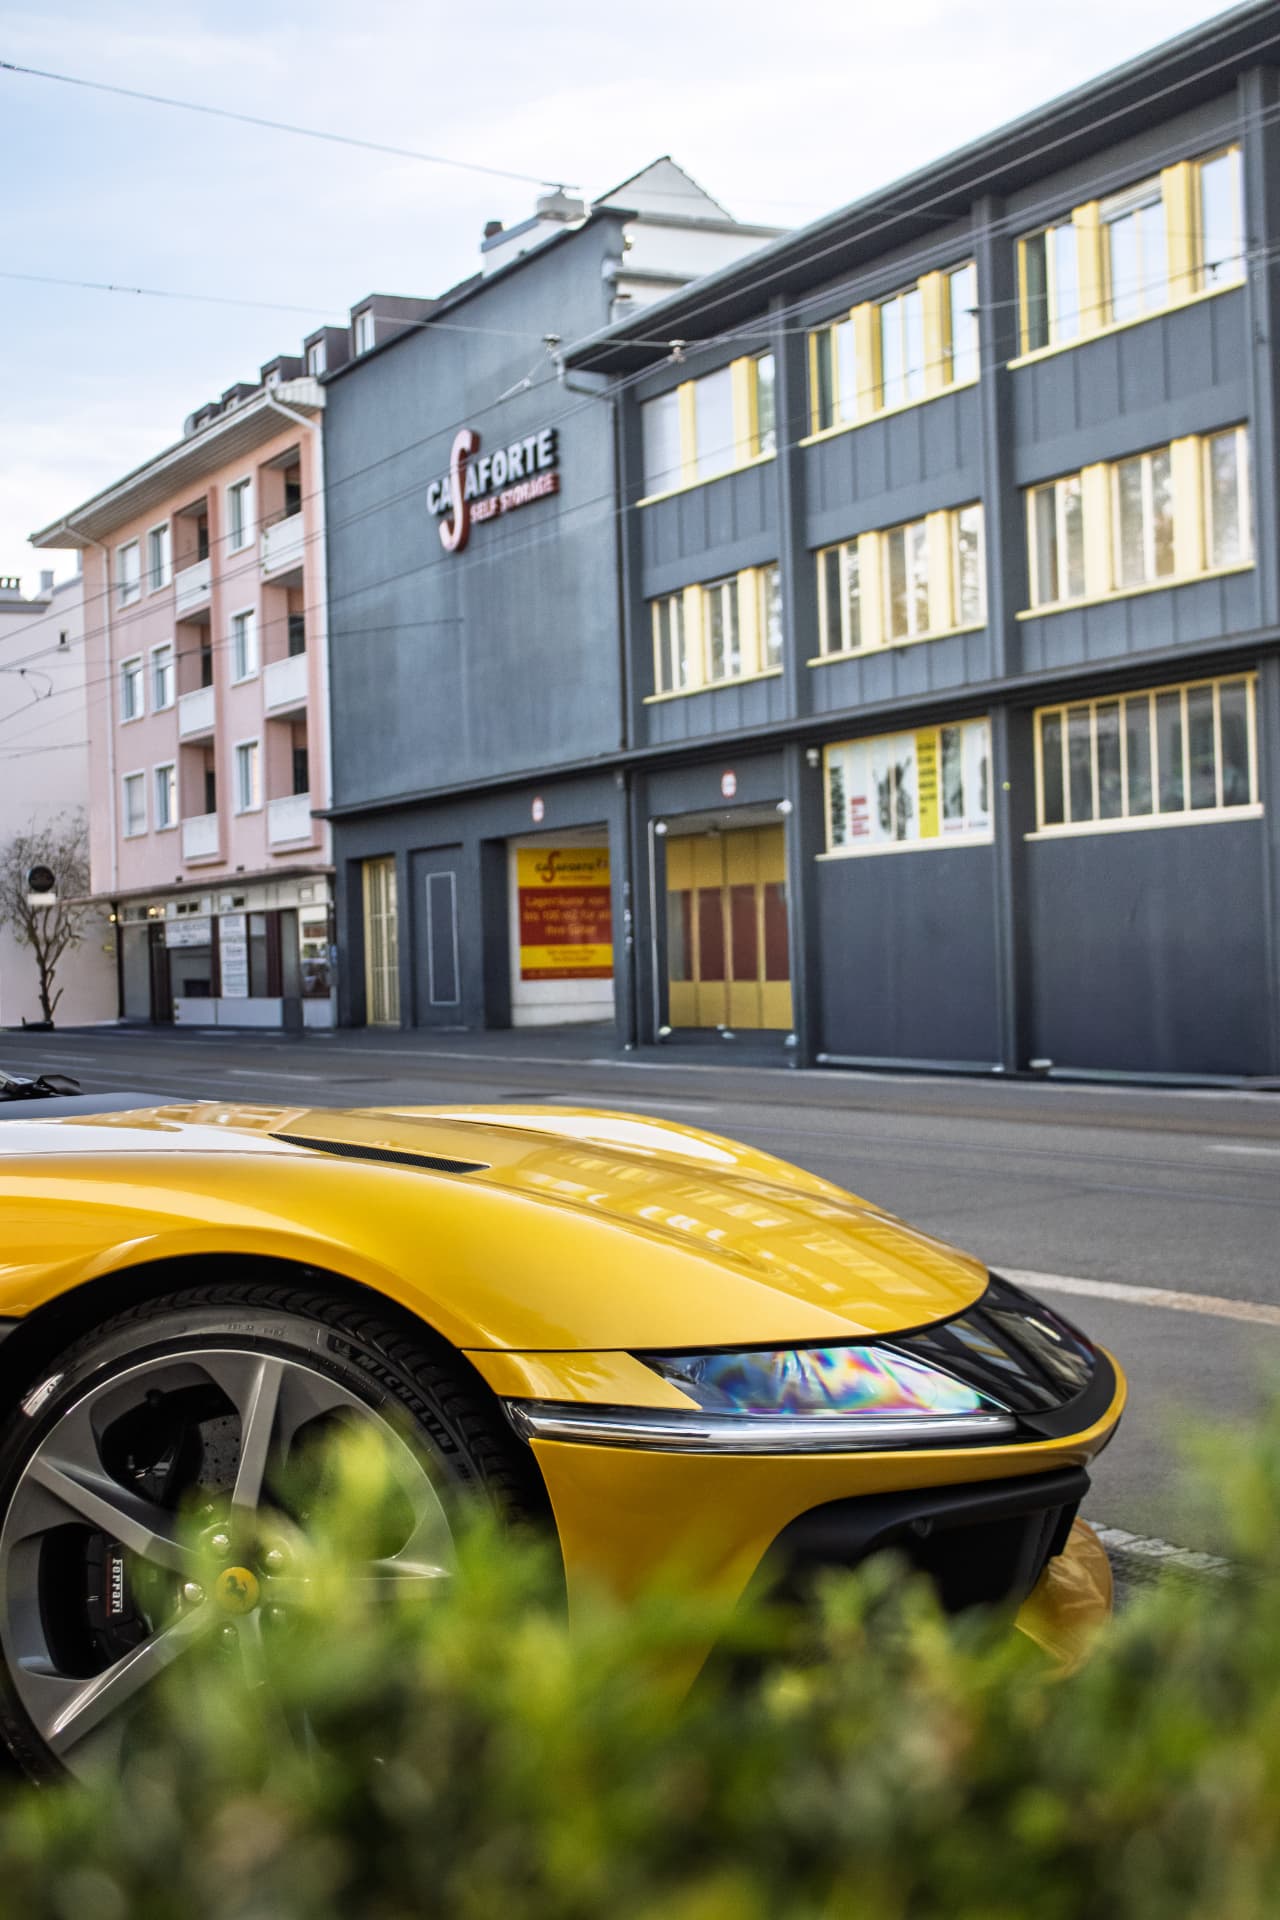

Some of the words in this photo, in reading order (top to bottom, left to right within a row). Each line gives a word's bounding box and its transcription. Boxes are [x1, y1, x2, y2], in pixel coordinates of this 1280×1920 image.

[426, 429, 557, 552] CASAFORTE
[469, 496, 498, 523] SELF
[499, 472, 558, 513] STORAGE
[354, 1354, 453, 1450] MICHELIN
[111, 1557, 124, 1614] Ferrari
